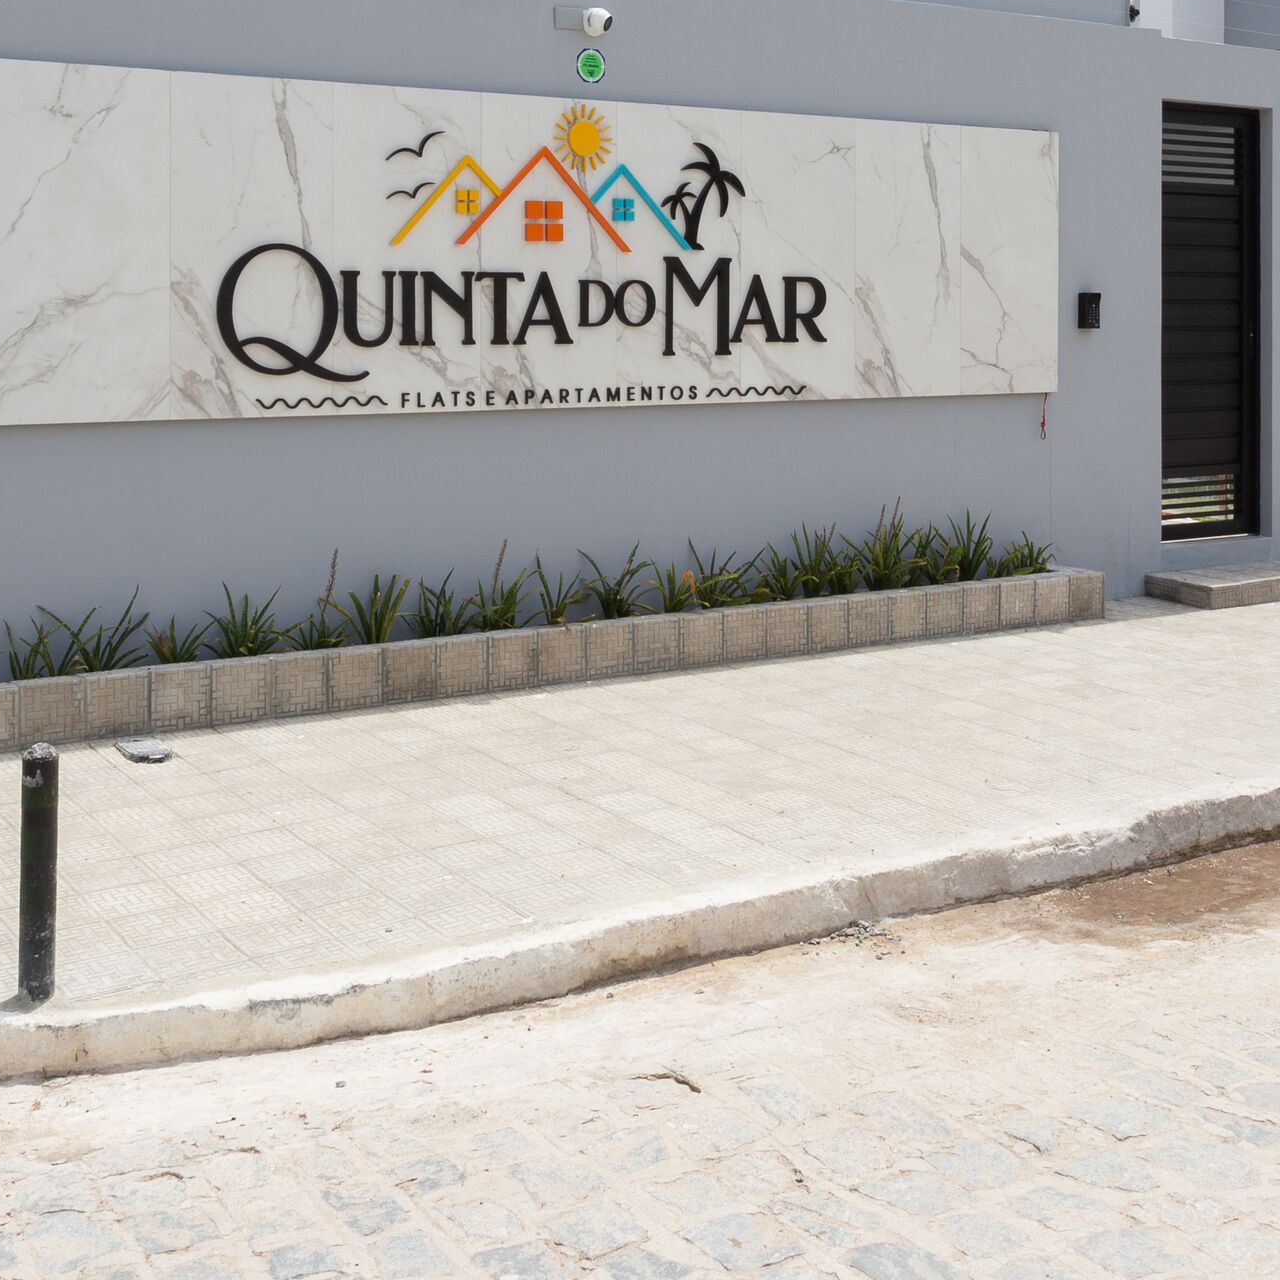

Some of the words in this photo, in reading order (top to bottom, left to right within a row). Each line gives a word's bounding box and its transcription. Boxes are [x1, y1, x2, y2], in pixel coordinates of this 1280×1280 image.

[216, 243, 574, 382] QUINTA
[577, 279, 656, 327] DO
[662, 256, 828, 356] MAR
[401, 391, 476, 408] FLATS
[486, 391, 495, 405] E
[505, 385, 698, 405] APARTAMENTOS
